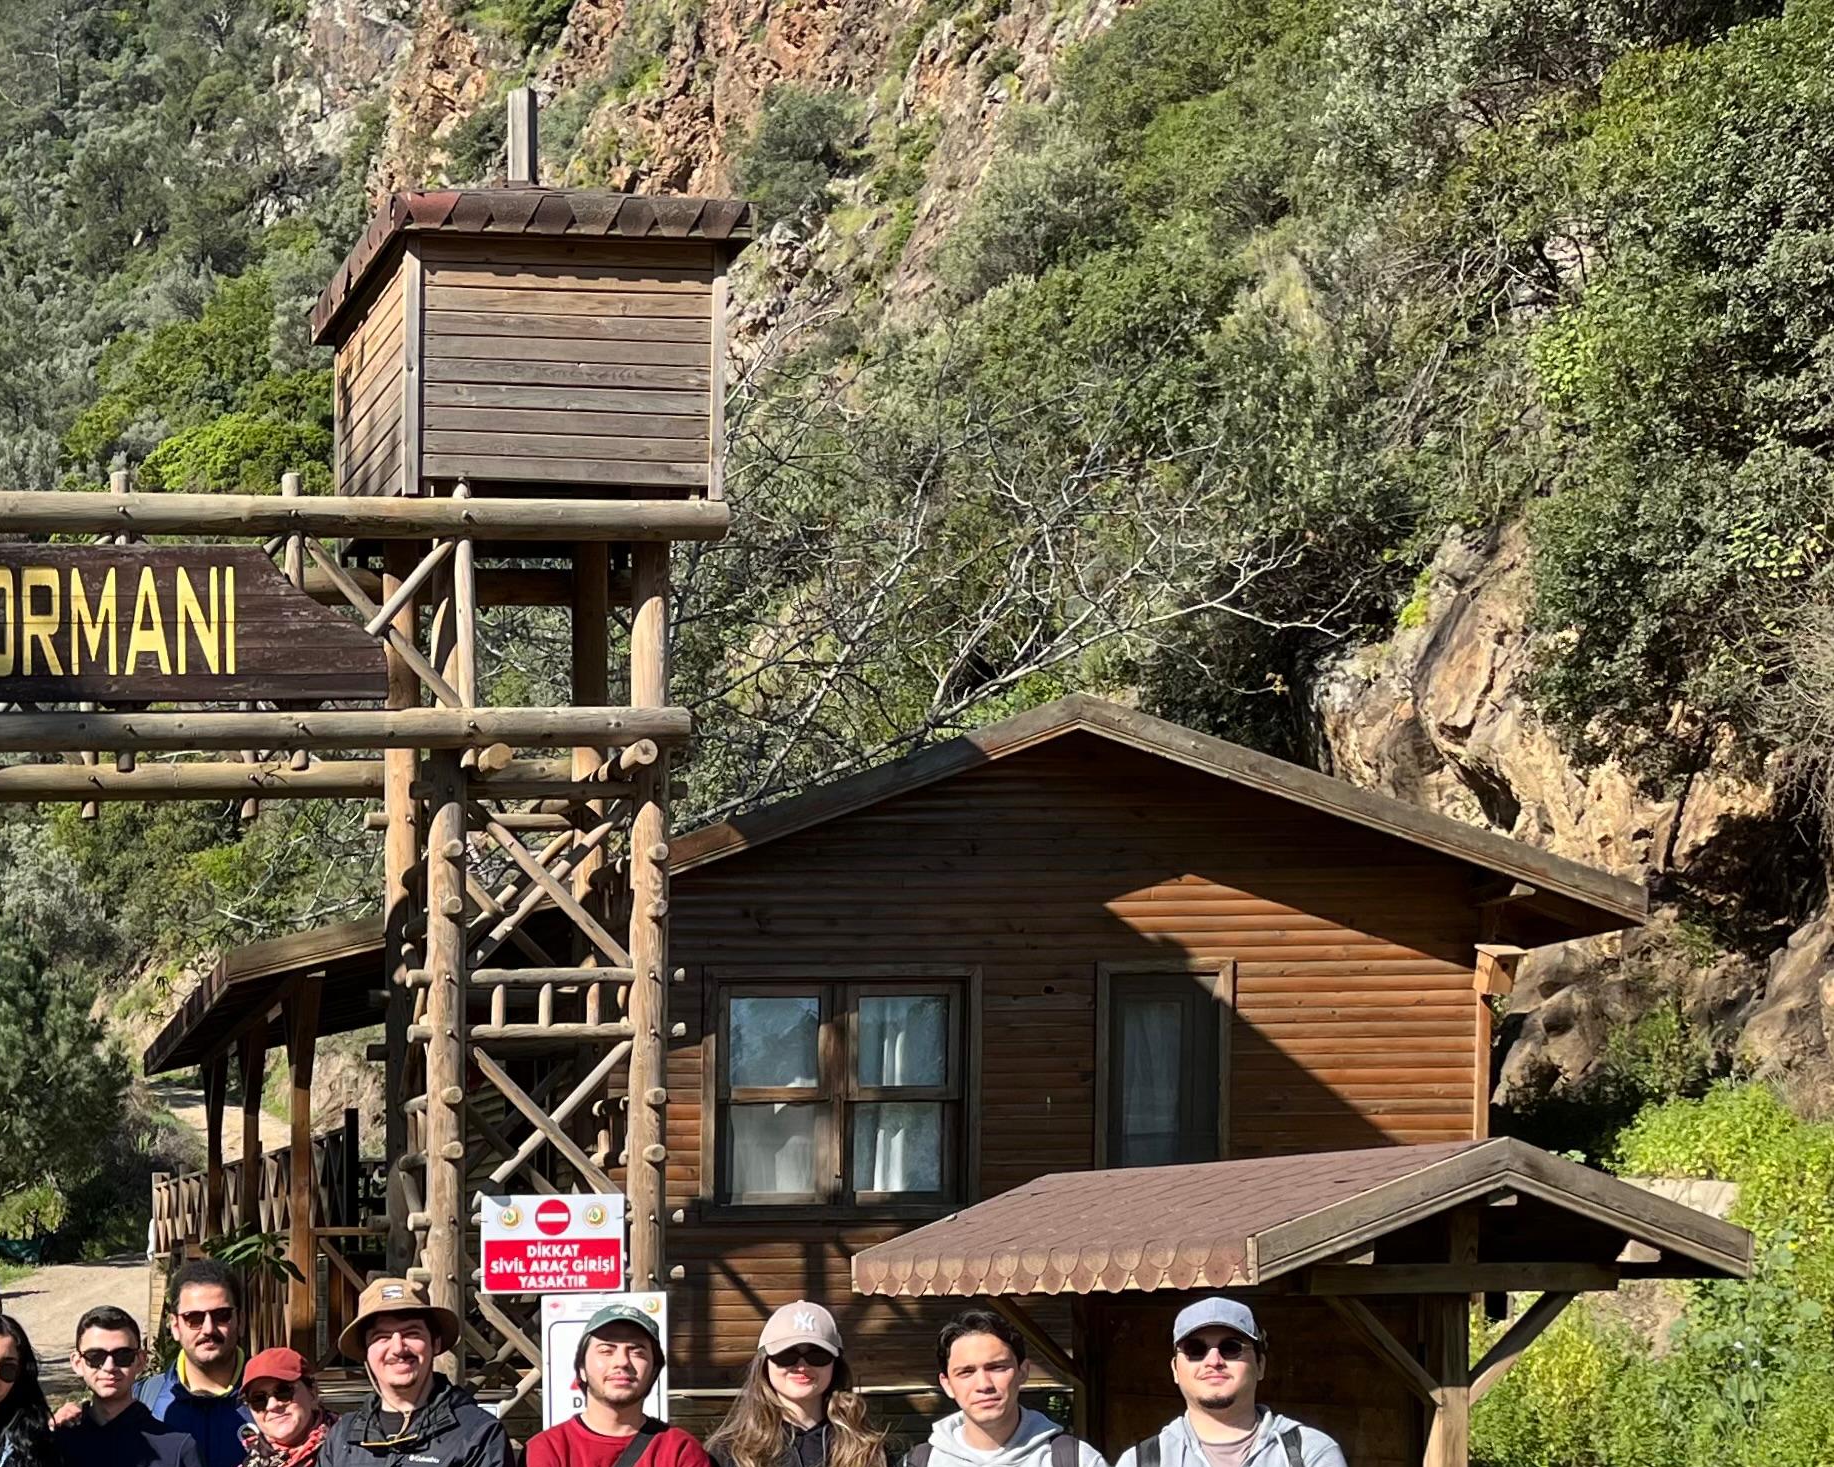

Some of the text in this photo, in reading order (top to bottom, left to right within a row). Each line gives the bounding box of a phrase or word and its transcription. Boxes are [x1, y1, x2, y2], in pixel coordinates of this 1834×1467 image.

[526, 1241, 580, 1258] DİKKAT
[490, 1256, 615, 1276] SİVİL ARAÇ GİRİŞİ
[518, 1275, 588, 1289] YASAKTIR
